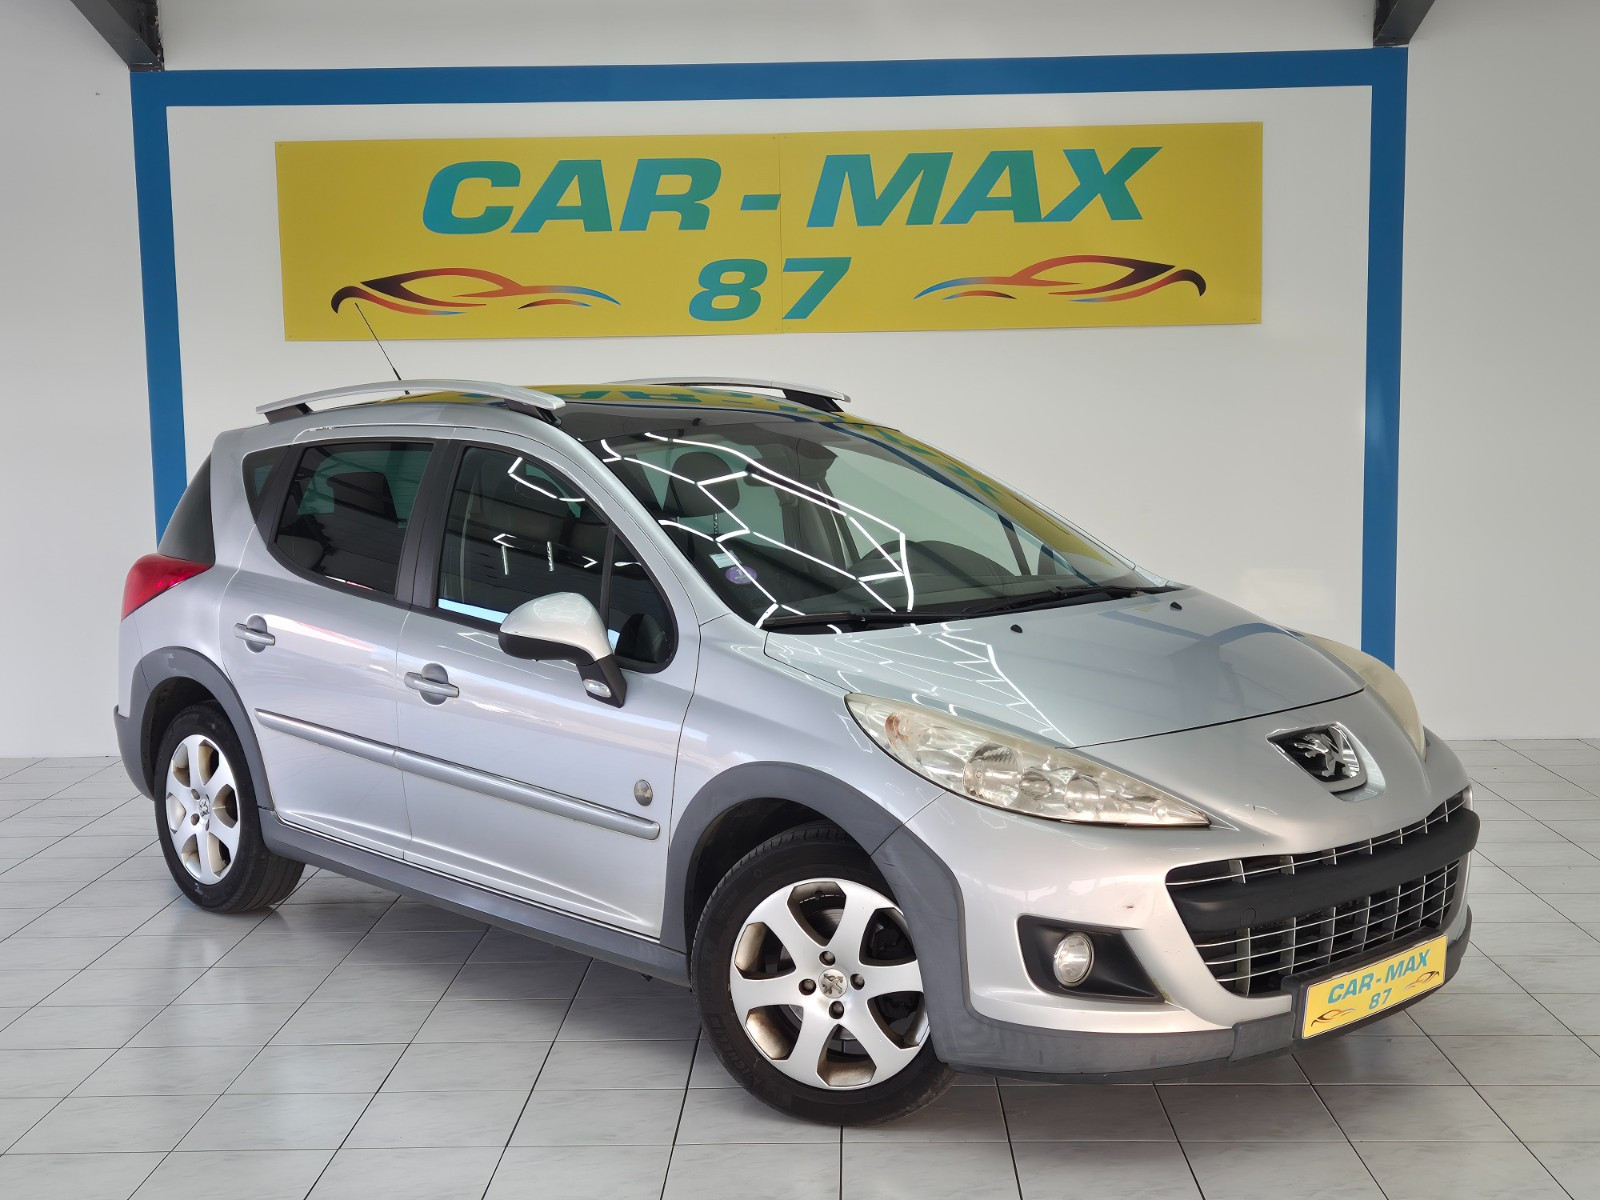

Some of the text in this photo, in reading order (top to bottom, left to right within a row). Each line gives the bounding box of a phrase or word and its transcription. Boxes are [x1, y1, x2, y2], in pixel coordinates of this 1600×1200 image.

[423, 158, 721, 235] CAR
[807, 147, 1162, 227] MAX
[689, 257, 852, 321] 87
[1369, 988, 1392, 1009] 87
